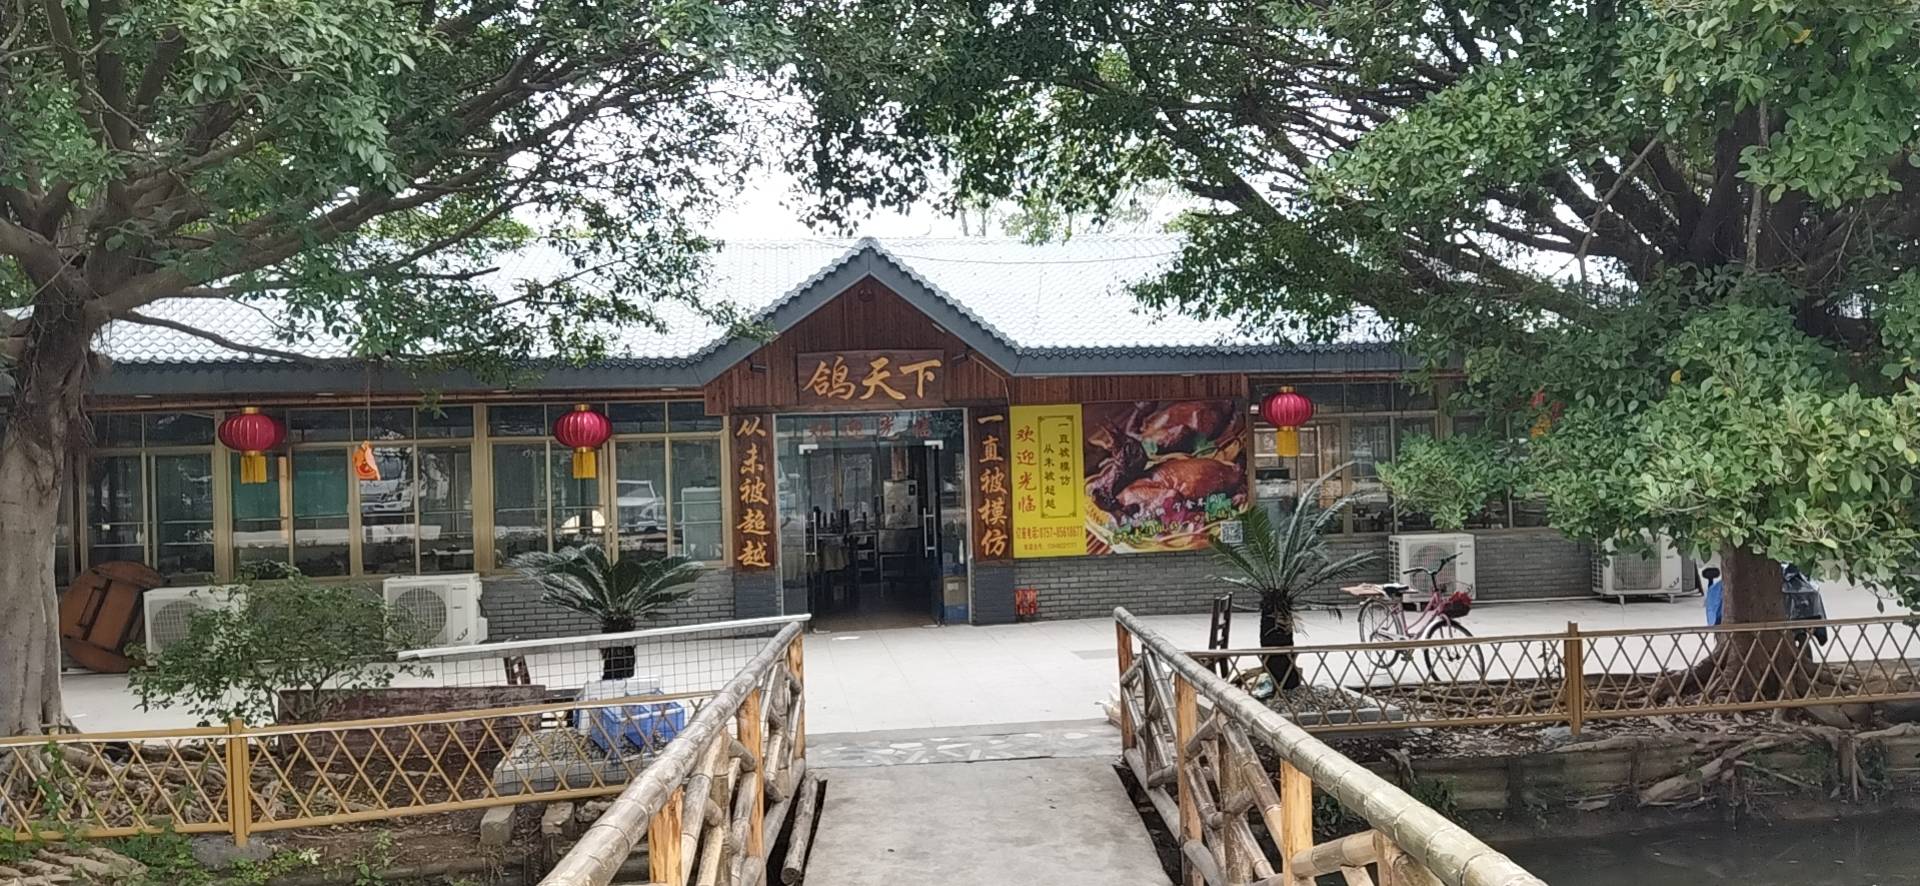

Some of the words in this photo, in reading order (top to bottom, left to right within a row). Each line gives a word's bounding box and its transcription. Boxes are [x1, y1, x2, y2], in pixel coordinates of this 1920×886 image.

[801, 355, 942, 400] 鸽天下
[736, 416, 771, 568] 从未被超越
[977, 414, 1008, 556] 一直被模仿
[1016, 425, 1037, 513] 欢迎光临
